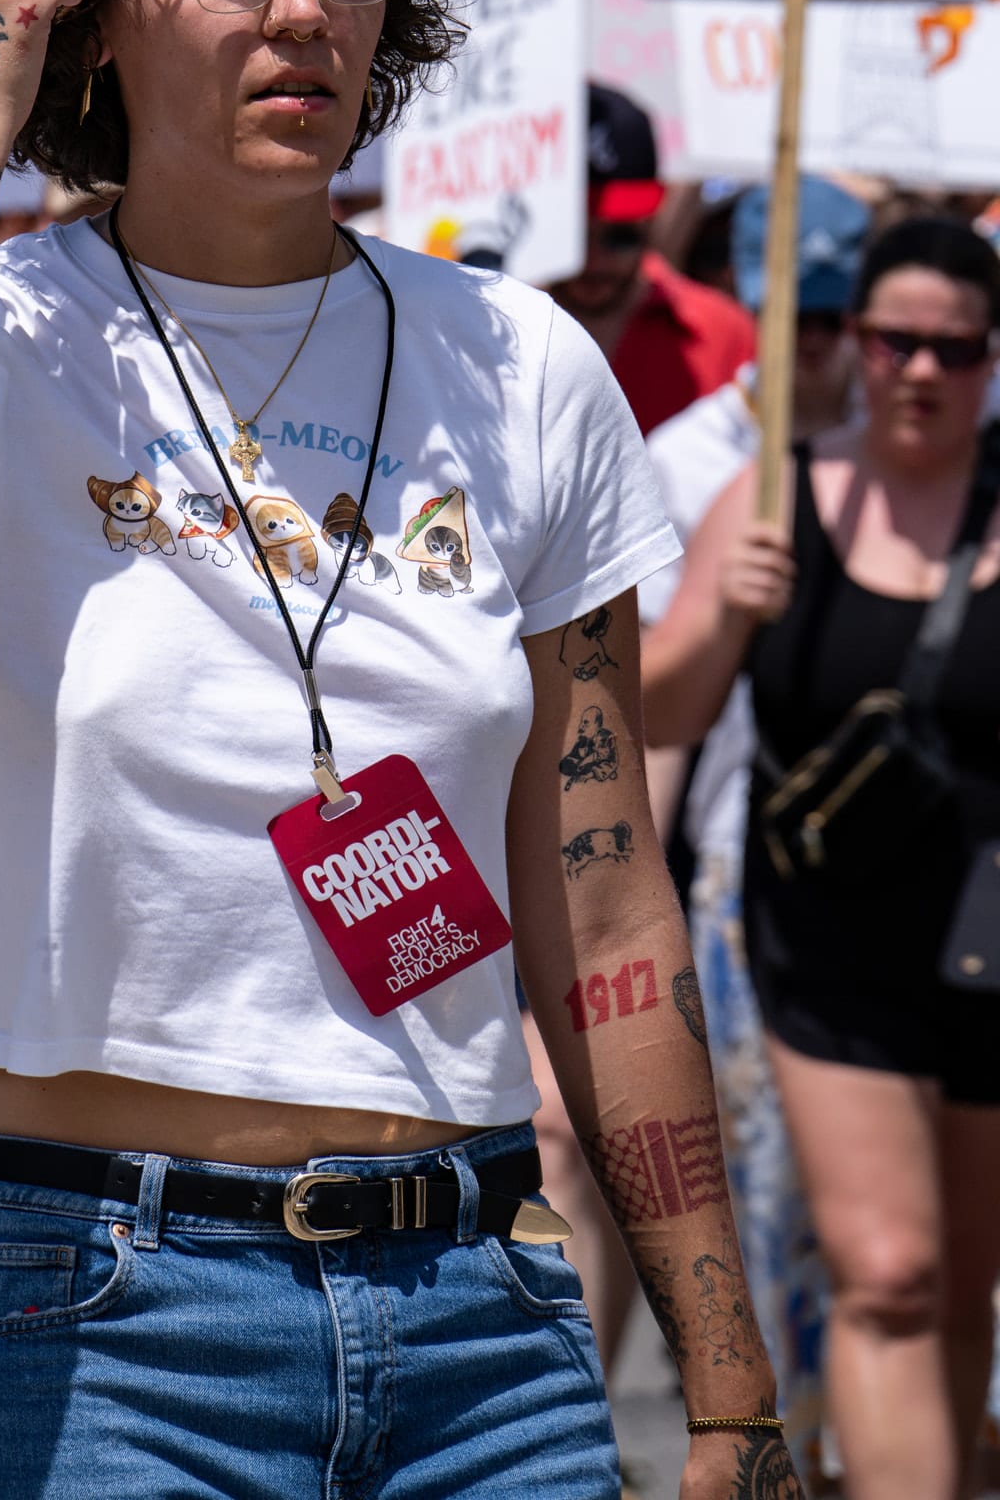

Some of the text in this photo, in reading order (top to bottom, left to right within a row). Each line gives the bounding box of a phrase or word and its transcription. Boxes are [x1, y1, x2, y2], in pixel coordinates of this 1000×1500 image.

[302, 810, 441, 902] COORDI-
[330, 841, 452, 928] NATOR
[385, 929, 480, 994] DEMOCRACY
[387, 904, 446, 954] FIGHT 4
[388, 922, 462, 973] PEOPLE'S
[564, 958, 658, 1034] 1917
